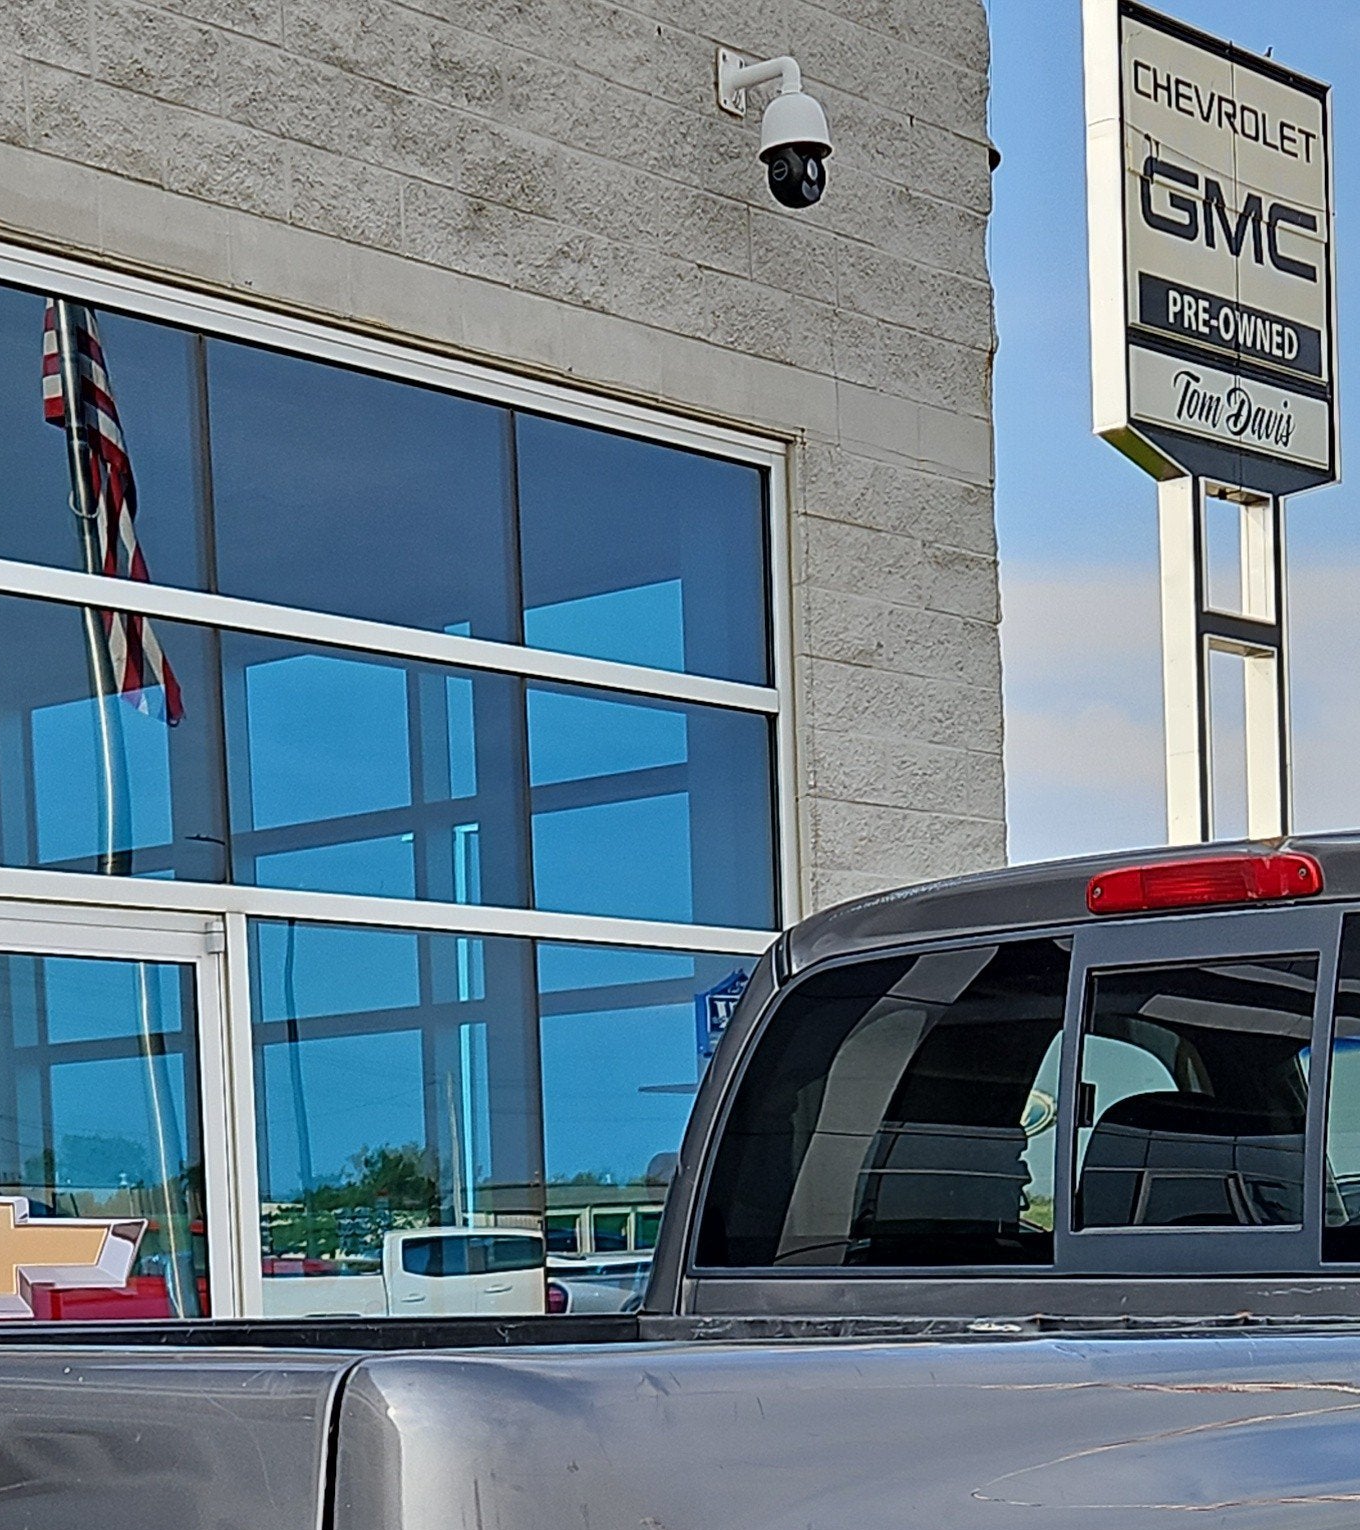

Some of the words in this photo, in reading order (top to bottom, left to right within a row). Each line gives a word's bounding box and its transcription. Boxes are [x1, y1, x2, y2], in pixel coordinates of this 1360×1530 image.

[1133, 59, 1317, 163] CHEVROLET
[1140, 155, 1318, 283] GMC
[1168, 289, 1299, 361] PRE-OWNED
[1173, 370, 1224, 422] Tom
[1226, 387, 1296, 449] Davis
